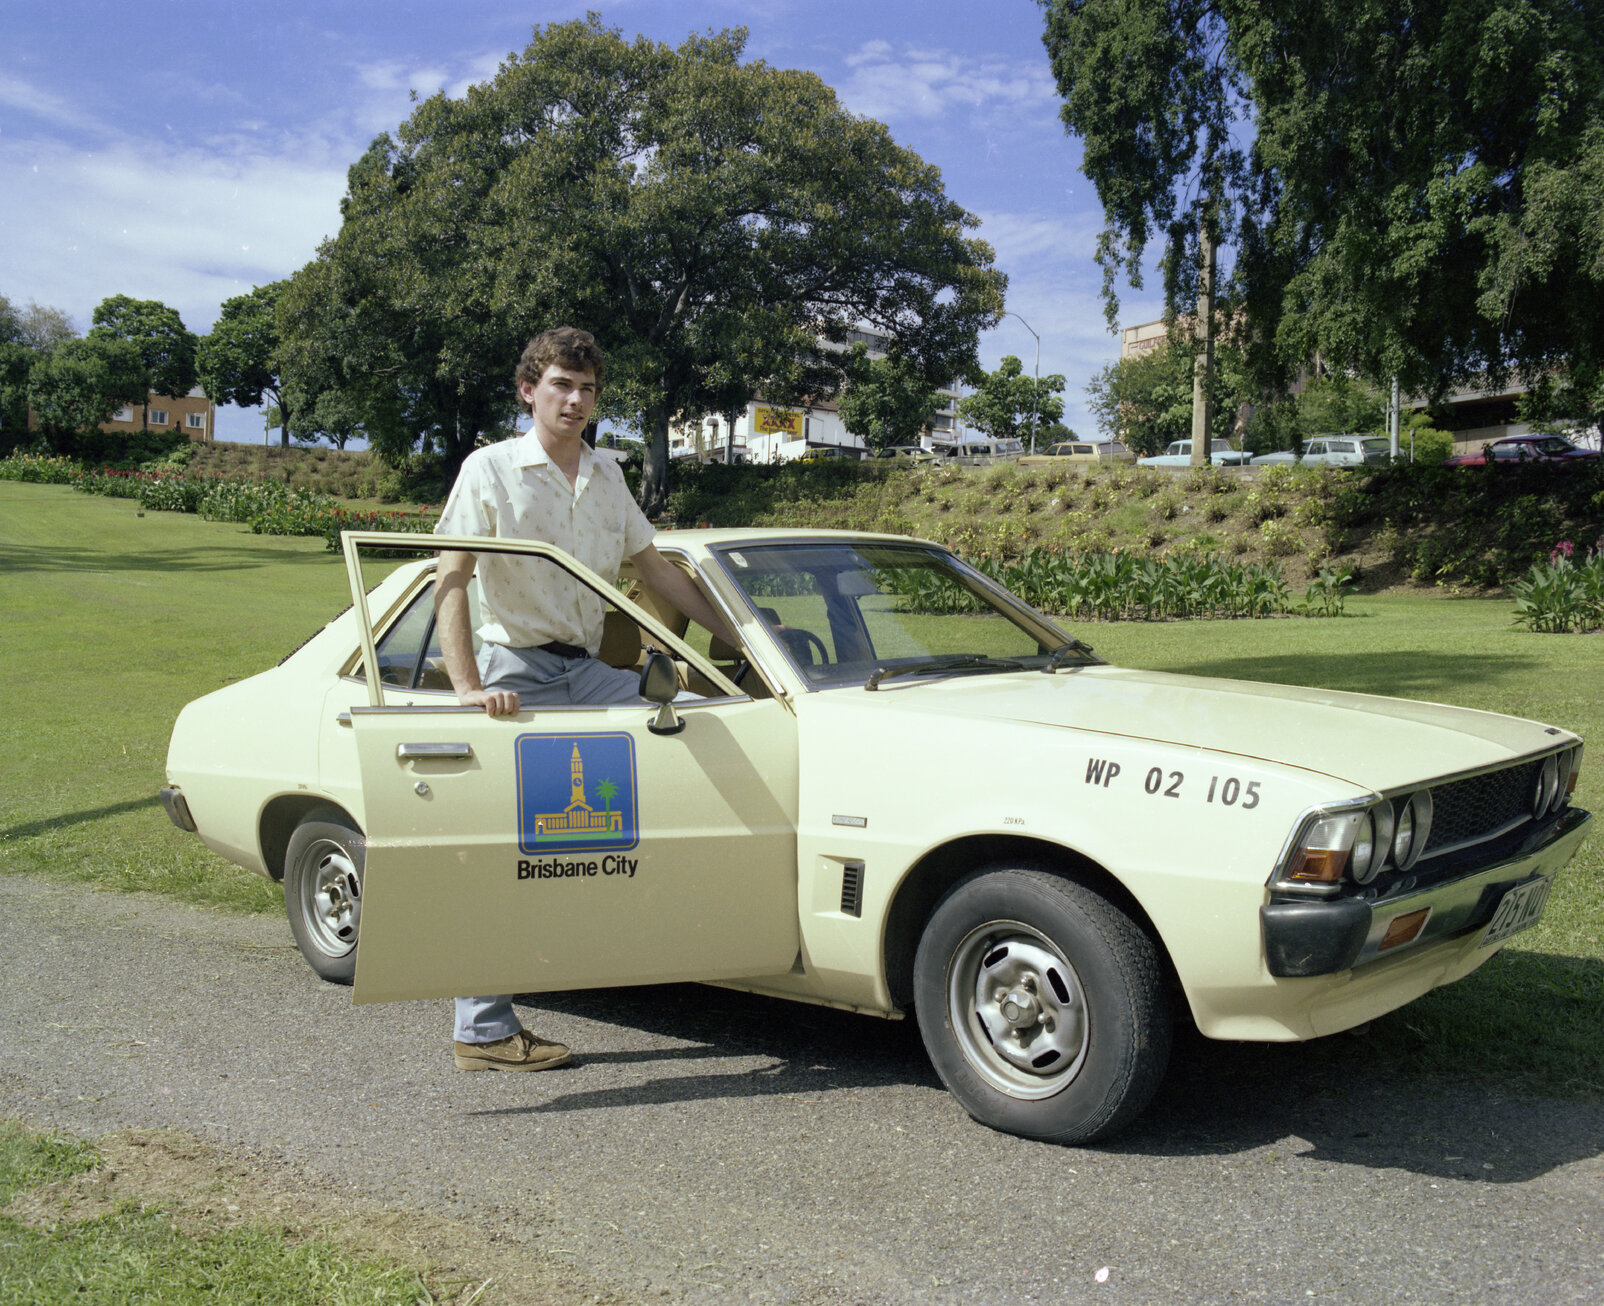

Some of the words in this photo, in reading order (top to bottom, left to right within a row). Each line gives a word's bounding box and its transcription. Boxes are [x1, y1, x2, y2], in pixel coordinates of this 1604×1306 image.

[1085, 757, 1121, 788] WP
[1144, 766, 1185, 799] 02
[1206, 776, 1262, 810] 105
[517, 858, 598, 881] Brisbane
[601, 855, 639, 878] City
